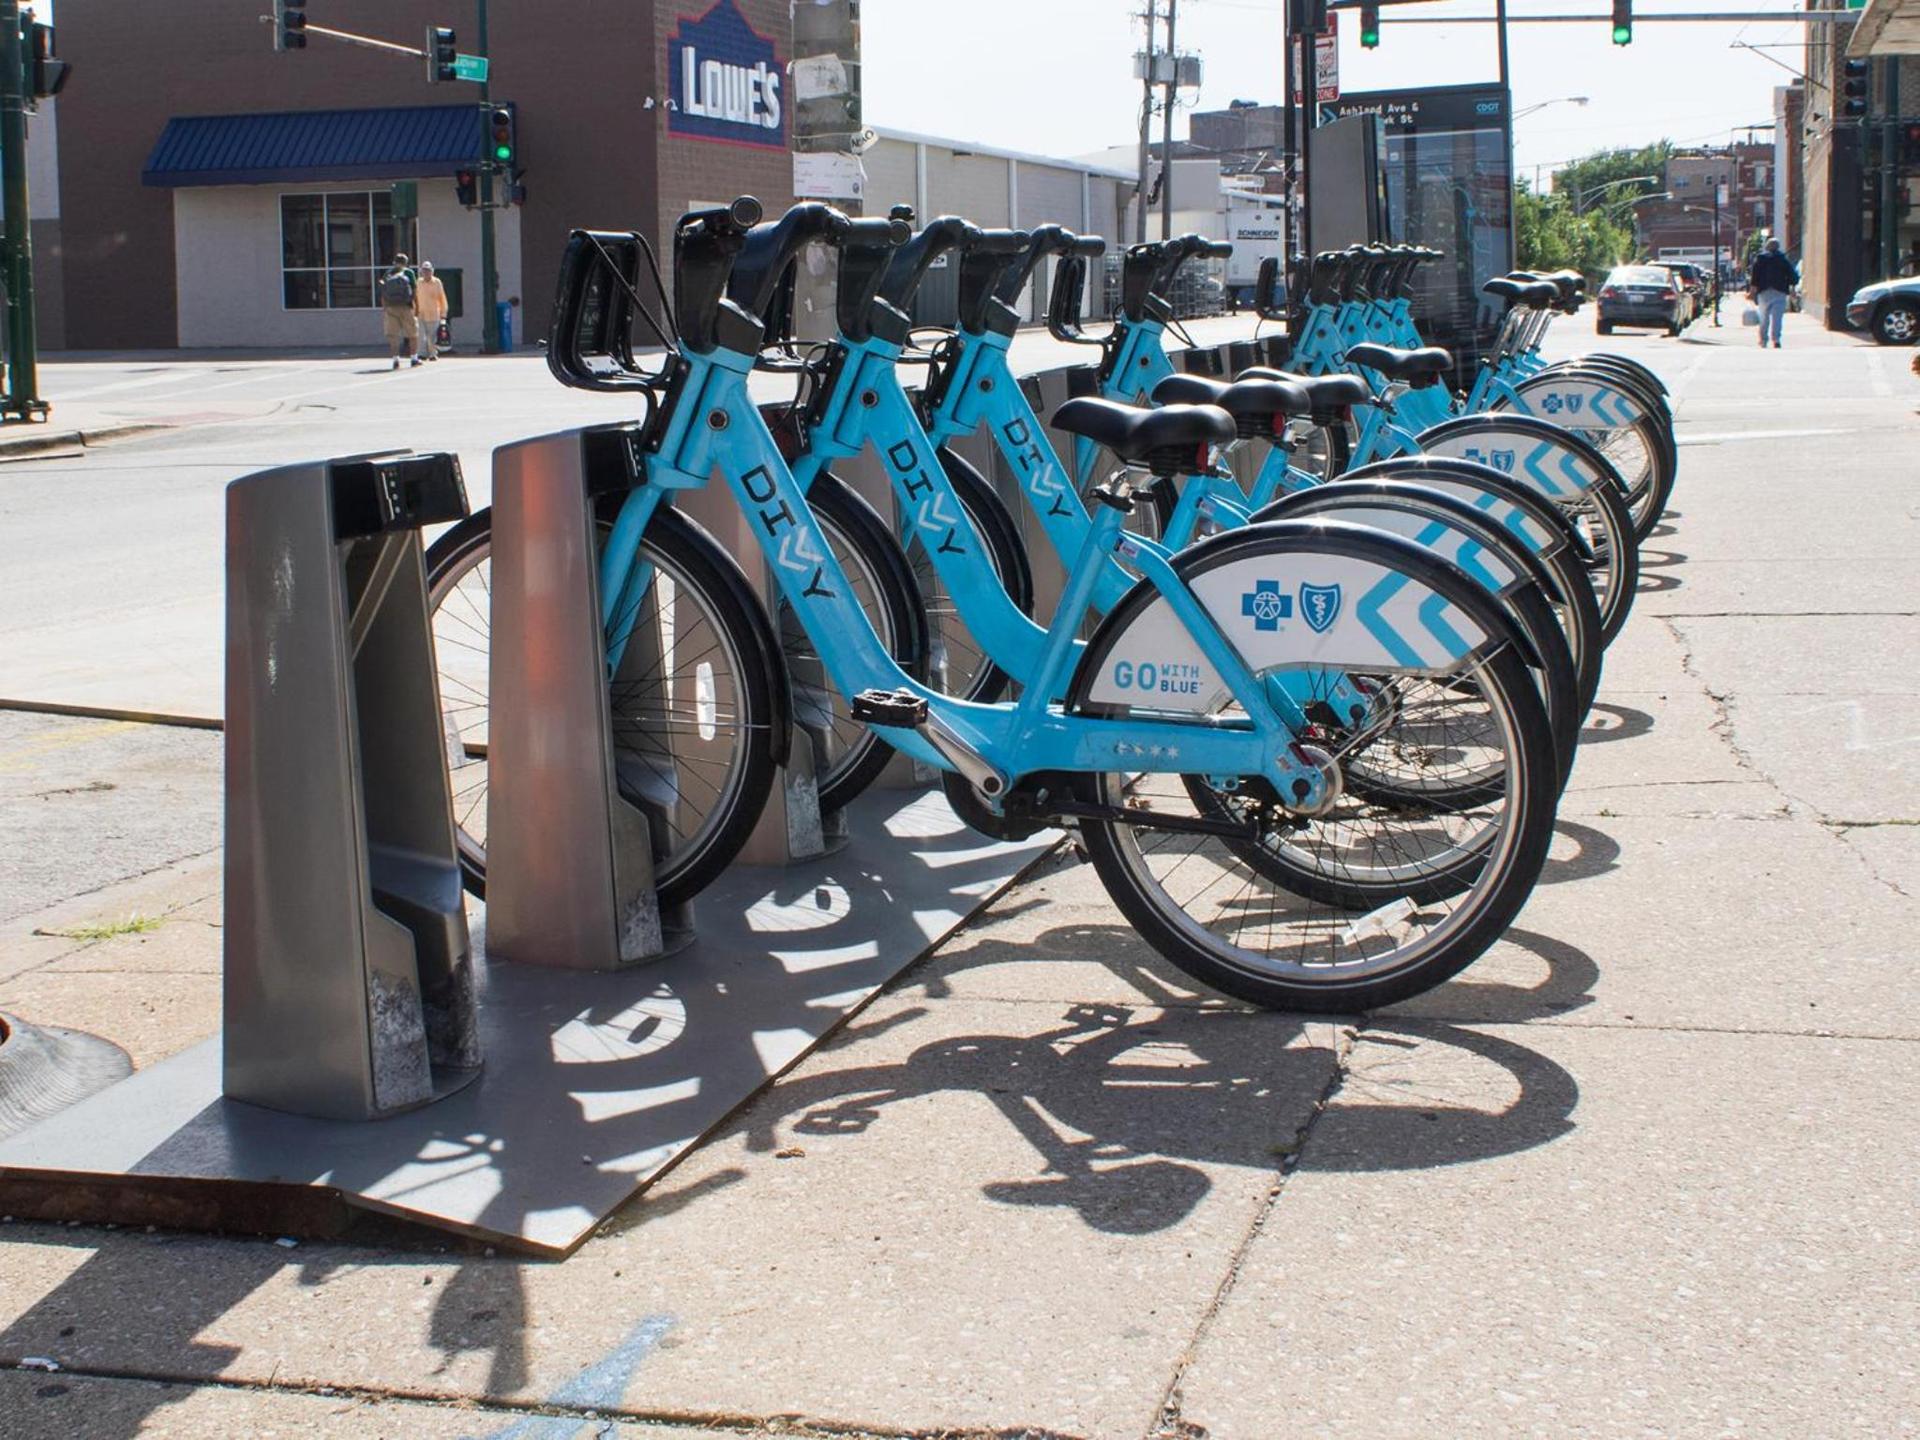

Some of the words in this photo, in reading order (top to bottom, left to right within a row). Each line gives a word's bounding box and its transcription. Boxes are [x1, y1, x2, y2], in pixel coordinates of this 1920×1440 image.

[1339, 104, 1382, 116] Ashland
[1387, 103, 1406, 113] Ave
[1400, 114, 1413, 124] St
[1237, 229, 1280, 237] SCHNEIDER
[1114, 660, 1157, 691] GO
[1160, 664, 1200, 678] WITH
[1160, 679, 1199, 694] BLUE
